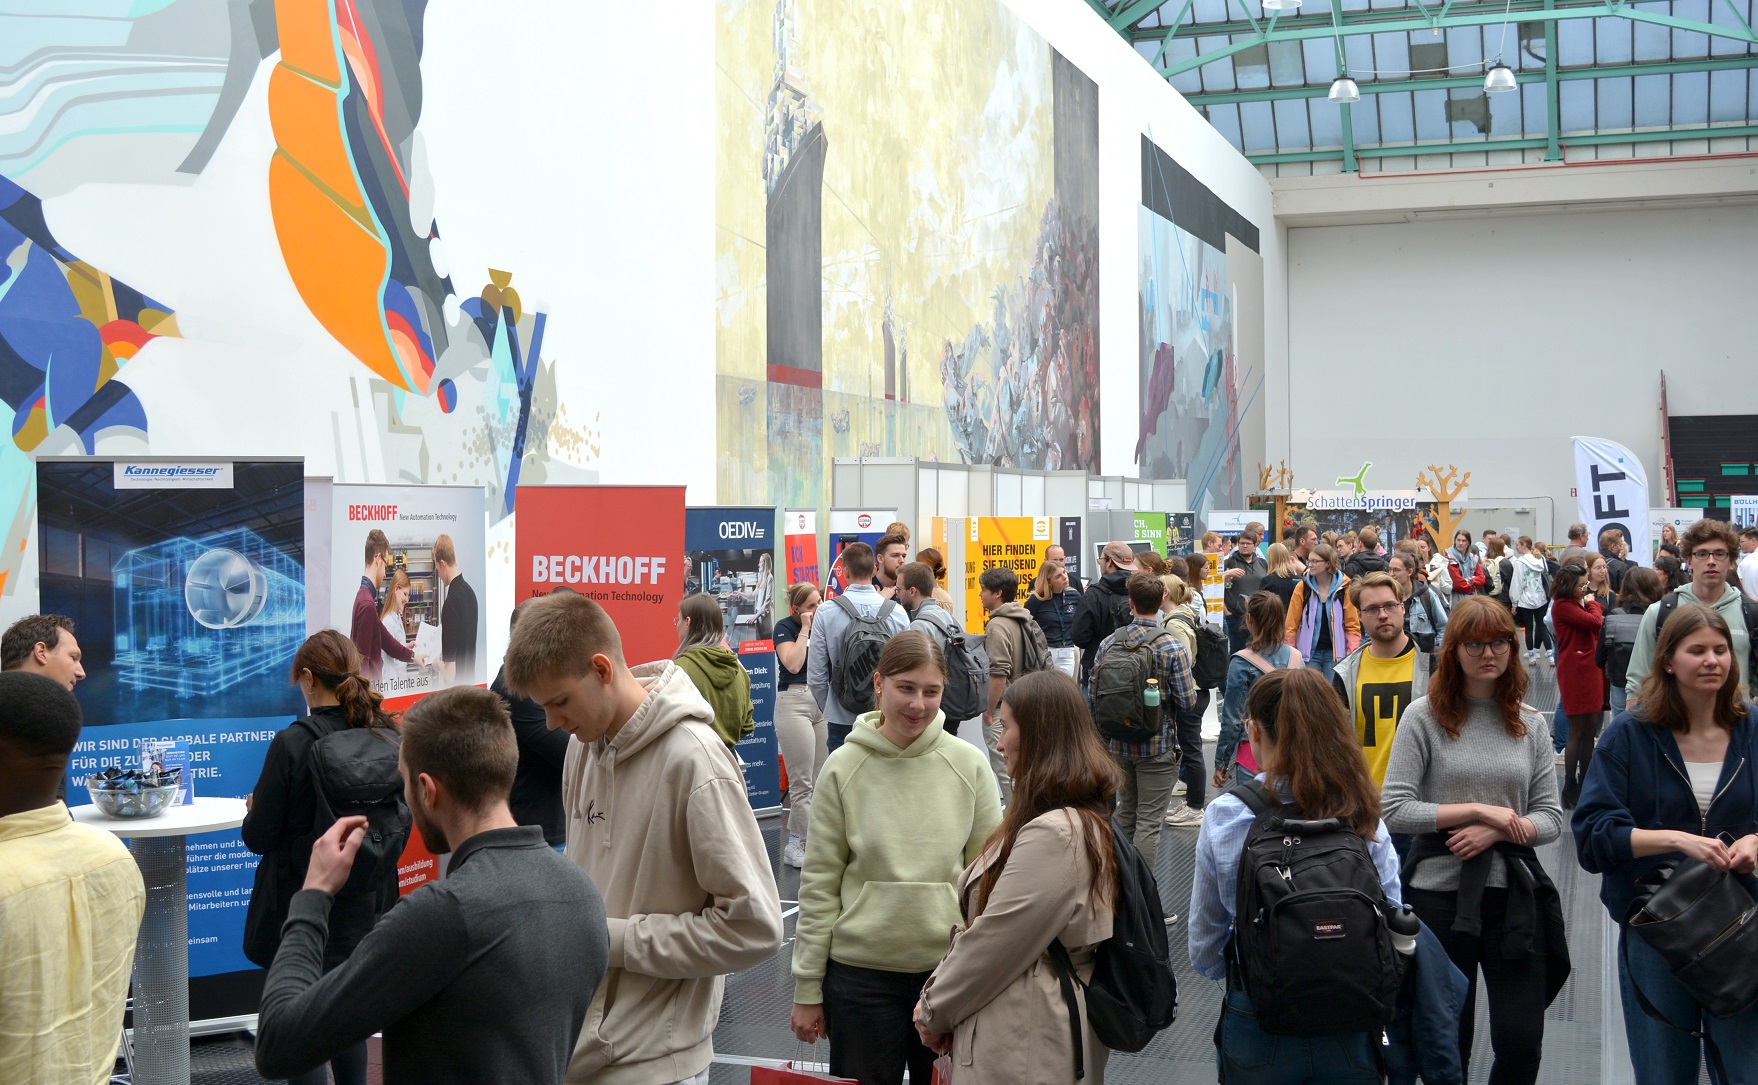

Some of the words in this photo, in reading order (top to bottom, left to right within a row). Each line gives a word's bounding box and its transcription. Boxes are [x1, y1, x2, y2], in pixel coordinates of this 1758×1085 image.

[124, 466, 220, 476] Kannegiesser
[1308, 495, 1415, 510] SchattenSpringer
[348, 504, 398, 521] BECKHOFF
[434, 514, 457, 522] Technology
[719, 522, 757, 538] OEDIV
[1142, 530, 1162, 538] SINN
[983, 545, 1002, 555] HIER
[1006, 544, 1036, 555] FINDEN
[532, 555, 666, 585] BECKHOFF
[983, 560, 997, 571] SIE
[999, 559, 1036, 570] TAUSEND
[1018, 574, 1032, 585] USS
[611, 591, 664, 604] Technology
[390, 678, 415, 690] Talente
[417, 676, 428, 687] aus
[99, 739, 129, 751] SIND
[220, 731, 276, 743] PARTNER
[72, 756, 97, 770] FÜR
[101, 756, 121, 767] DIE
[211, 863, 243, 872] unserer
[224, 888, 239, 897] und
[189, 900, 240, 911] Mitarbeitern
